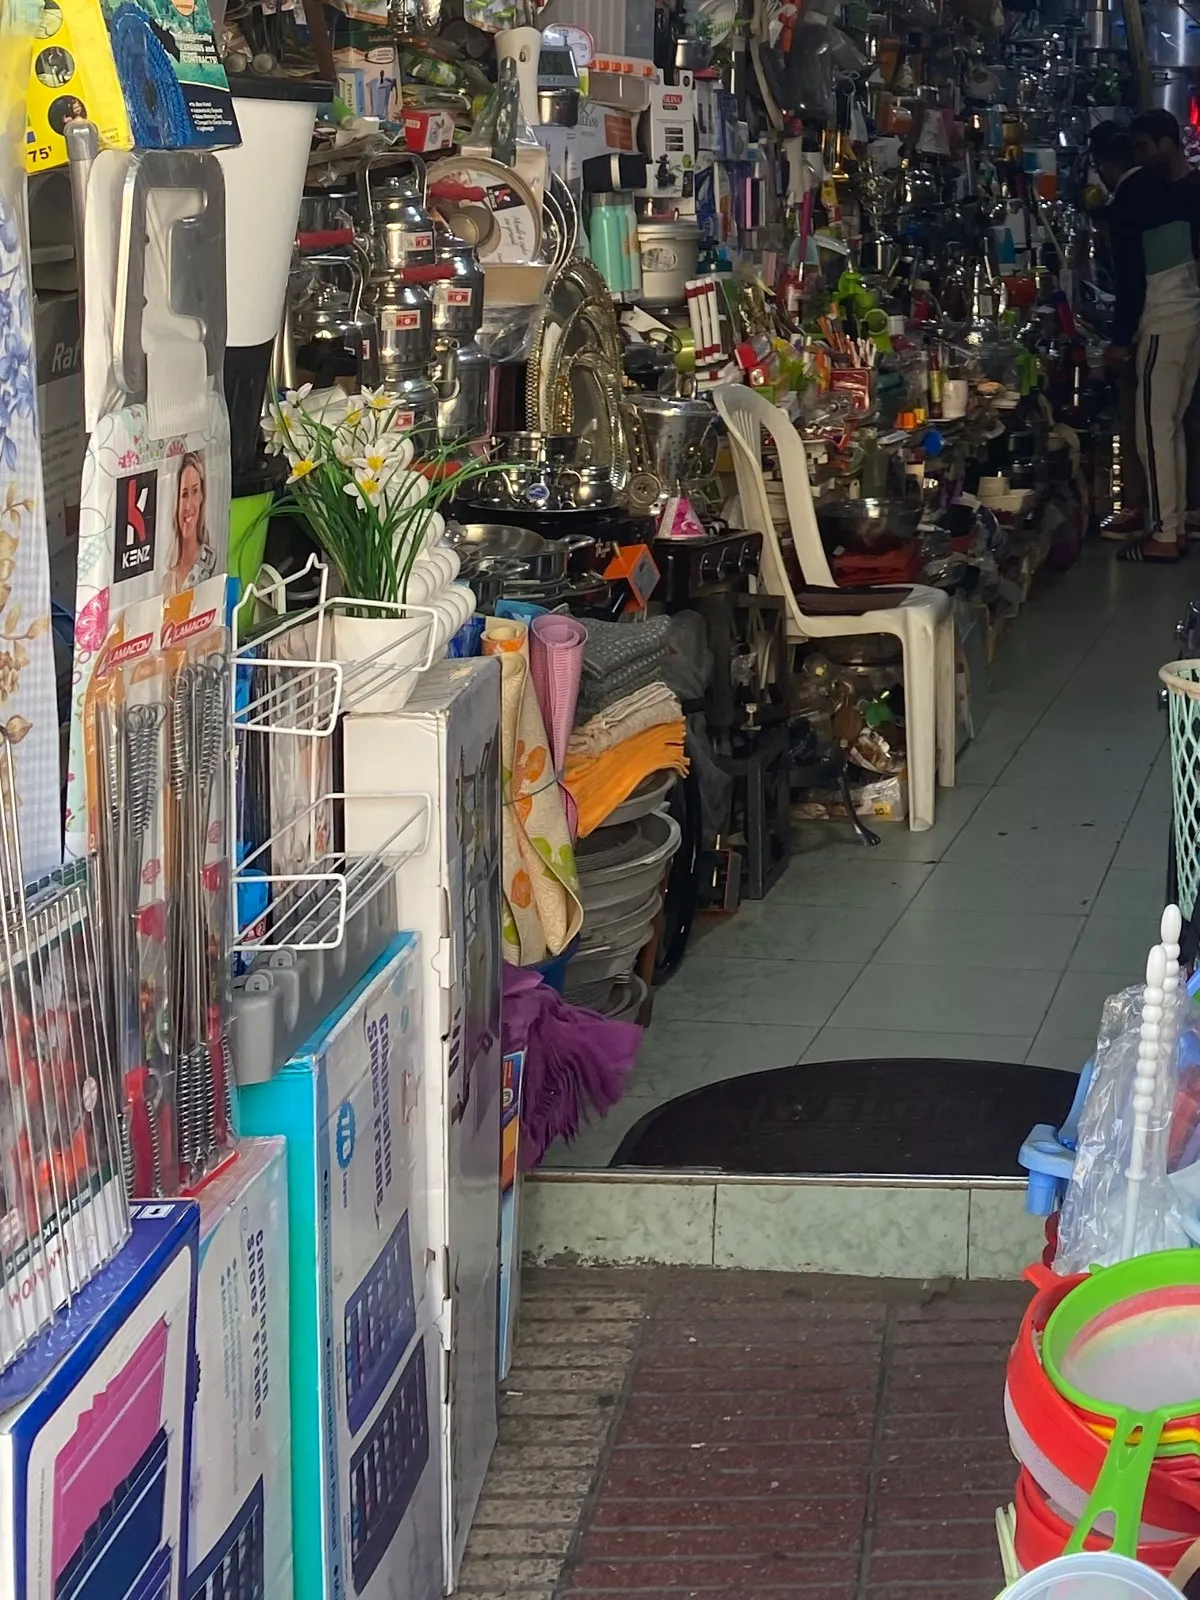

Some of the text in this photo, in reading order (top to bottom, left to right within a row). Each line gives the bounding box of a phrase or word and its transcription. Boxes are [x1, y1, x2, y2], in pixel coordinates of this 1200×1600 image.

[28, 145, 53, 163] 75'
[121, 545, 151, 570] KENZ
[109, 635, 152, 663] LAMACOM
[174, 614, 213, 640] LAMACOM
[366, 1019, 385, 1208] Shoes Frame
[378, 1012, 394, 1188] Combination
[247, 1232, 262, 1421] Shoes Frame
[255, 1228, 270, 1402] Combination
